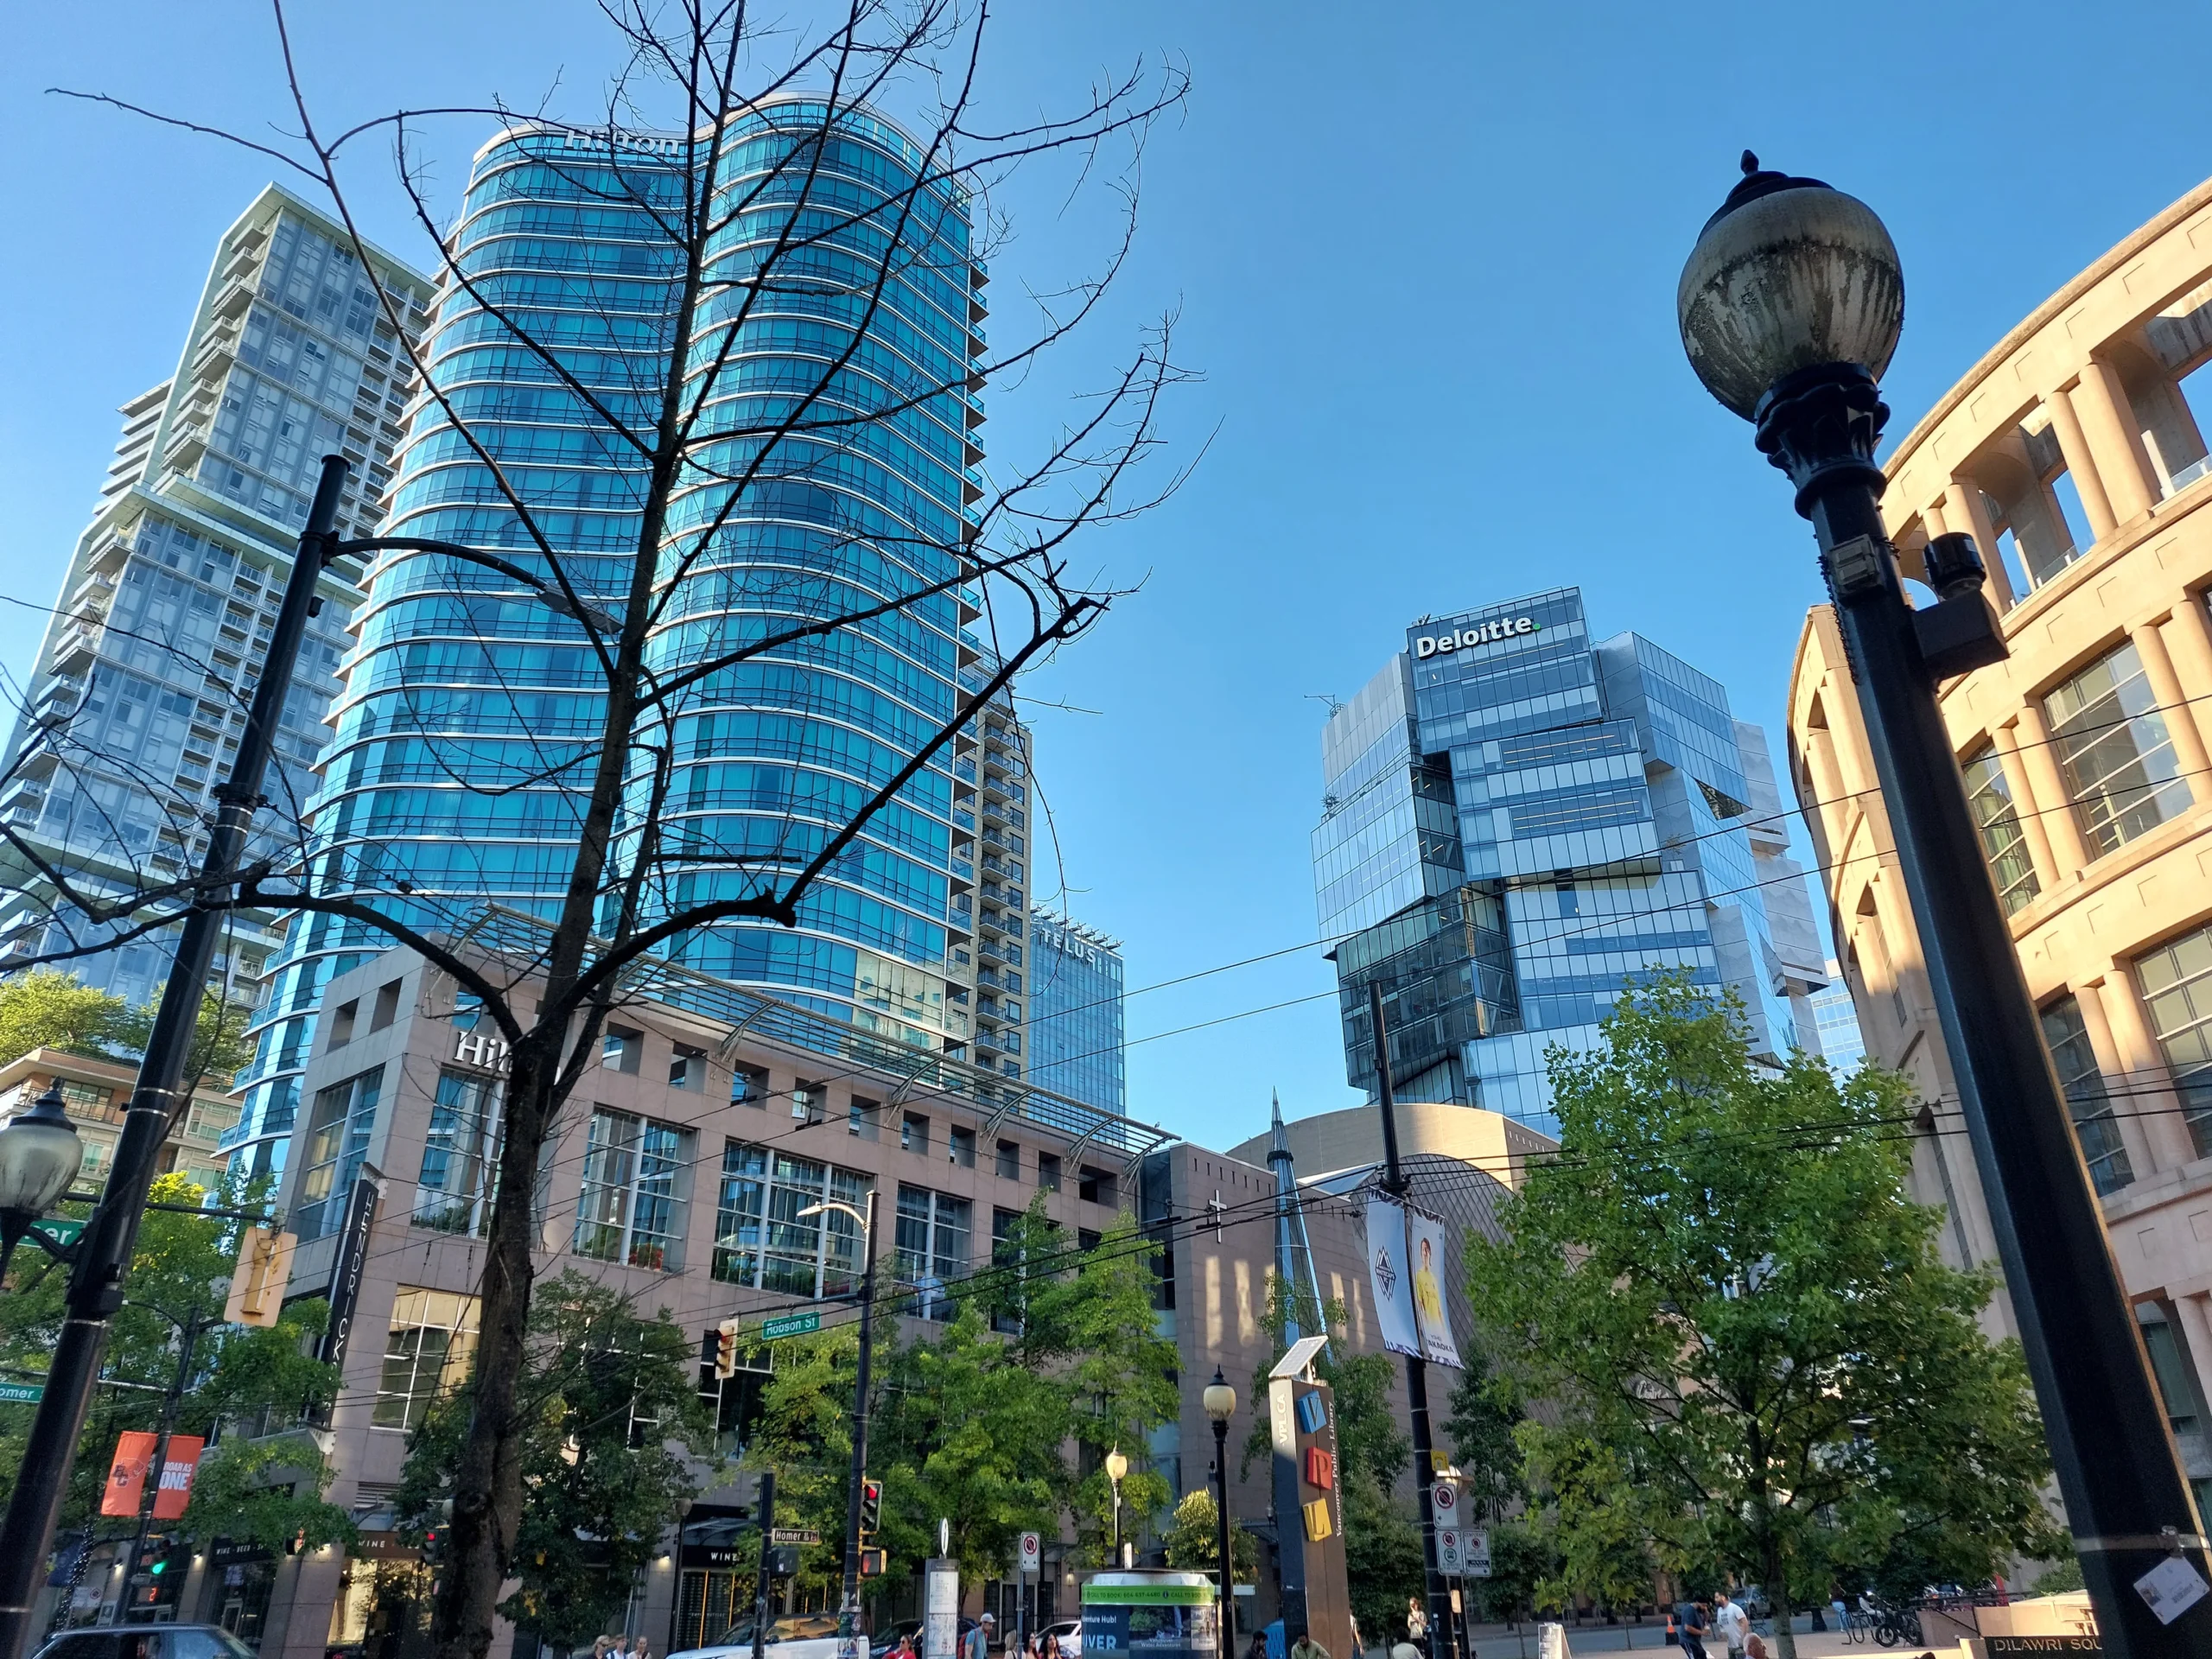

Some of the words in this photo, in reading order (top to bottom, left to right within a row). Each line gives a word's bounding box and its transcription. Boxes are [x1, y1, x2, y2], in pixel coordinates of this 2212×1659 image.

[1042, 927, 1096, 963] TELUS
[331, 1192, 374, 1370] HENDRICK
[766, 1319, 801, 1336] Robson
[804, 1315, 816, 1329] St
[1427, 1338, 1455, 1353] AKAOKA
[1327, 1401, 1336, 1440] Library
[182, 1463, 193, 1472] AS
[159, 1471, 190, 1491] ONE
[1333, 1480, 1343, 1538] Vancouver
[776, 1531, 801, 1541] Homer
[710, 1552, 738, 1561] WINE
[1102, 1615, 1116, 1624] Hub!
[1995, 1639, 2063, 1651] DILAWRI
[2071, 1638, 2103, 1650] SQU
